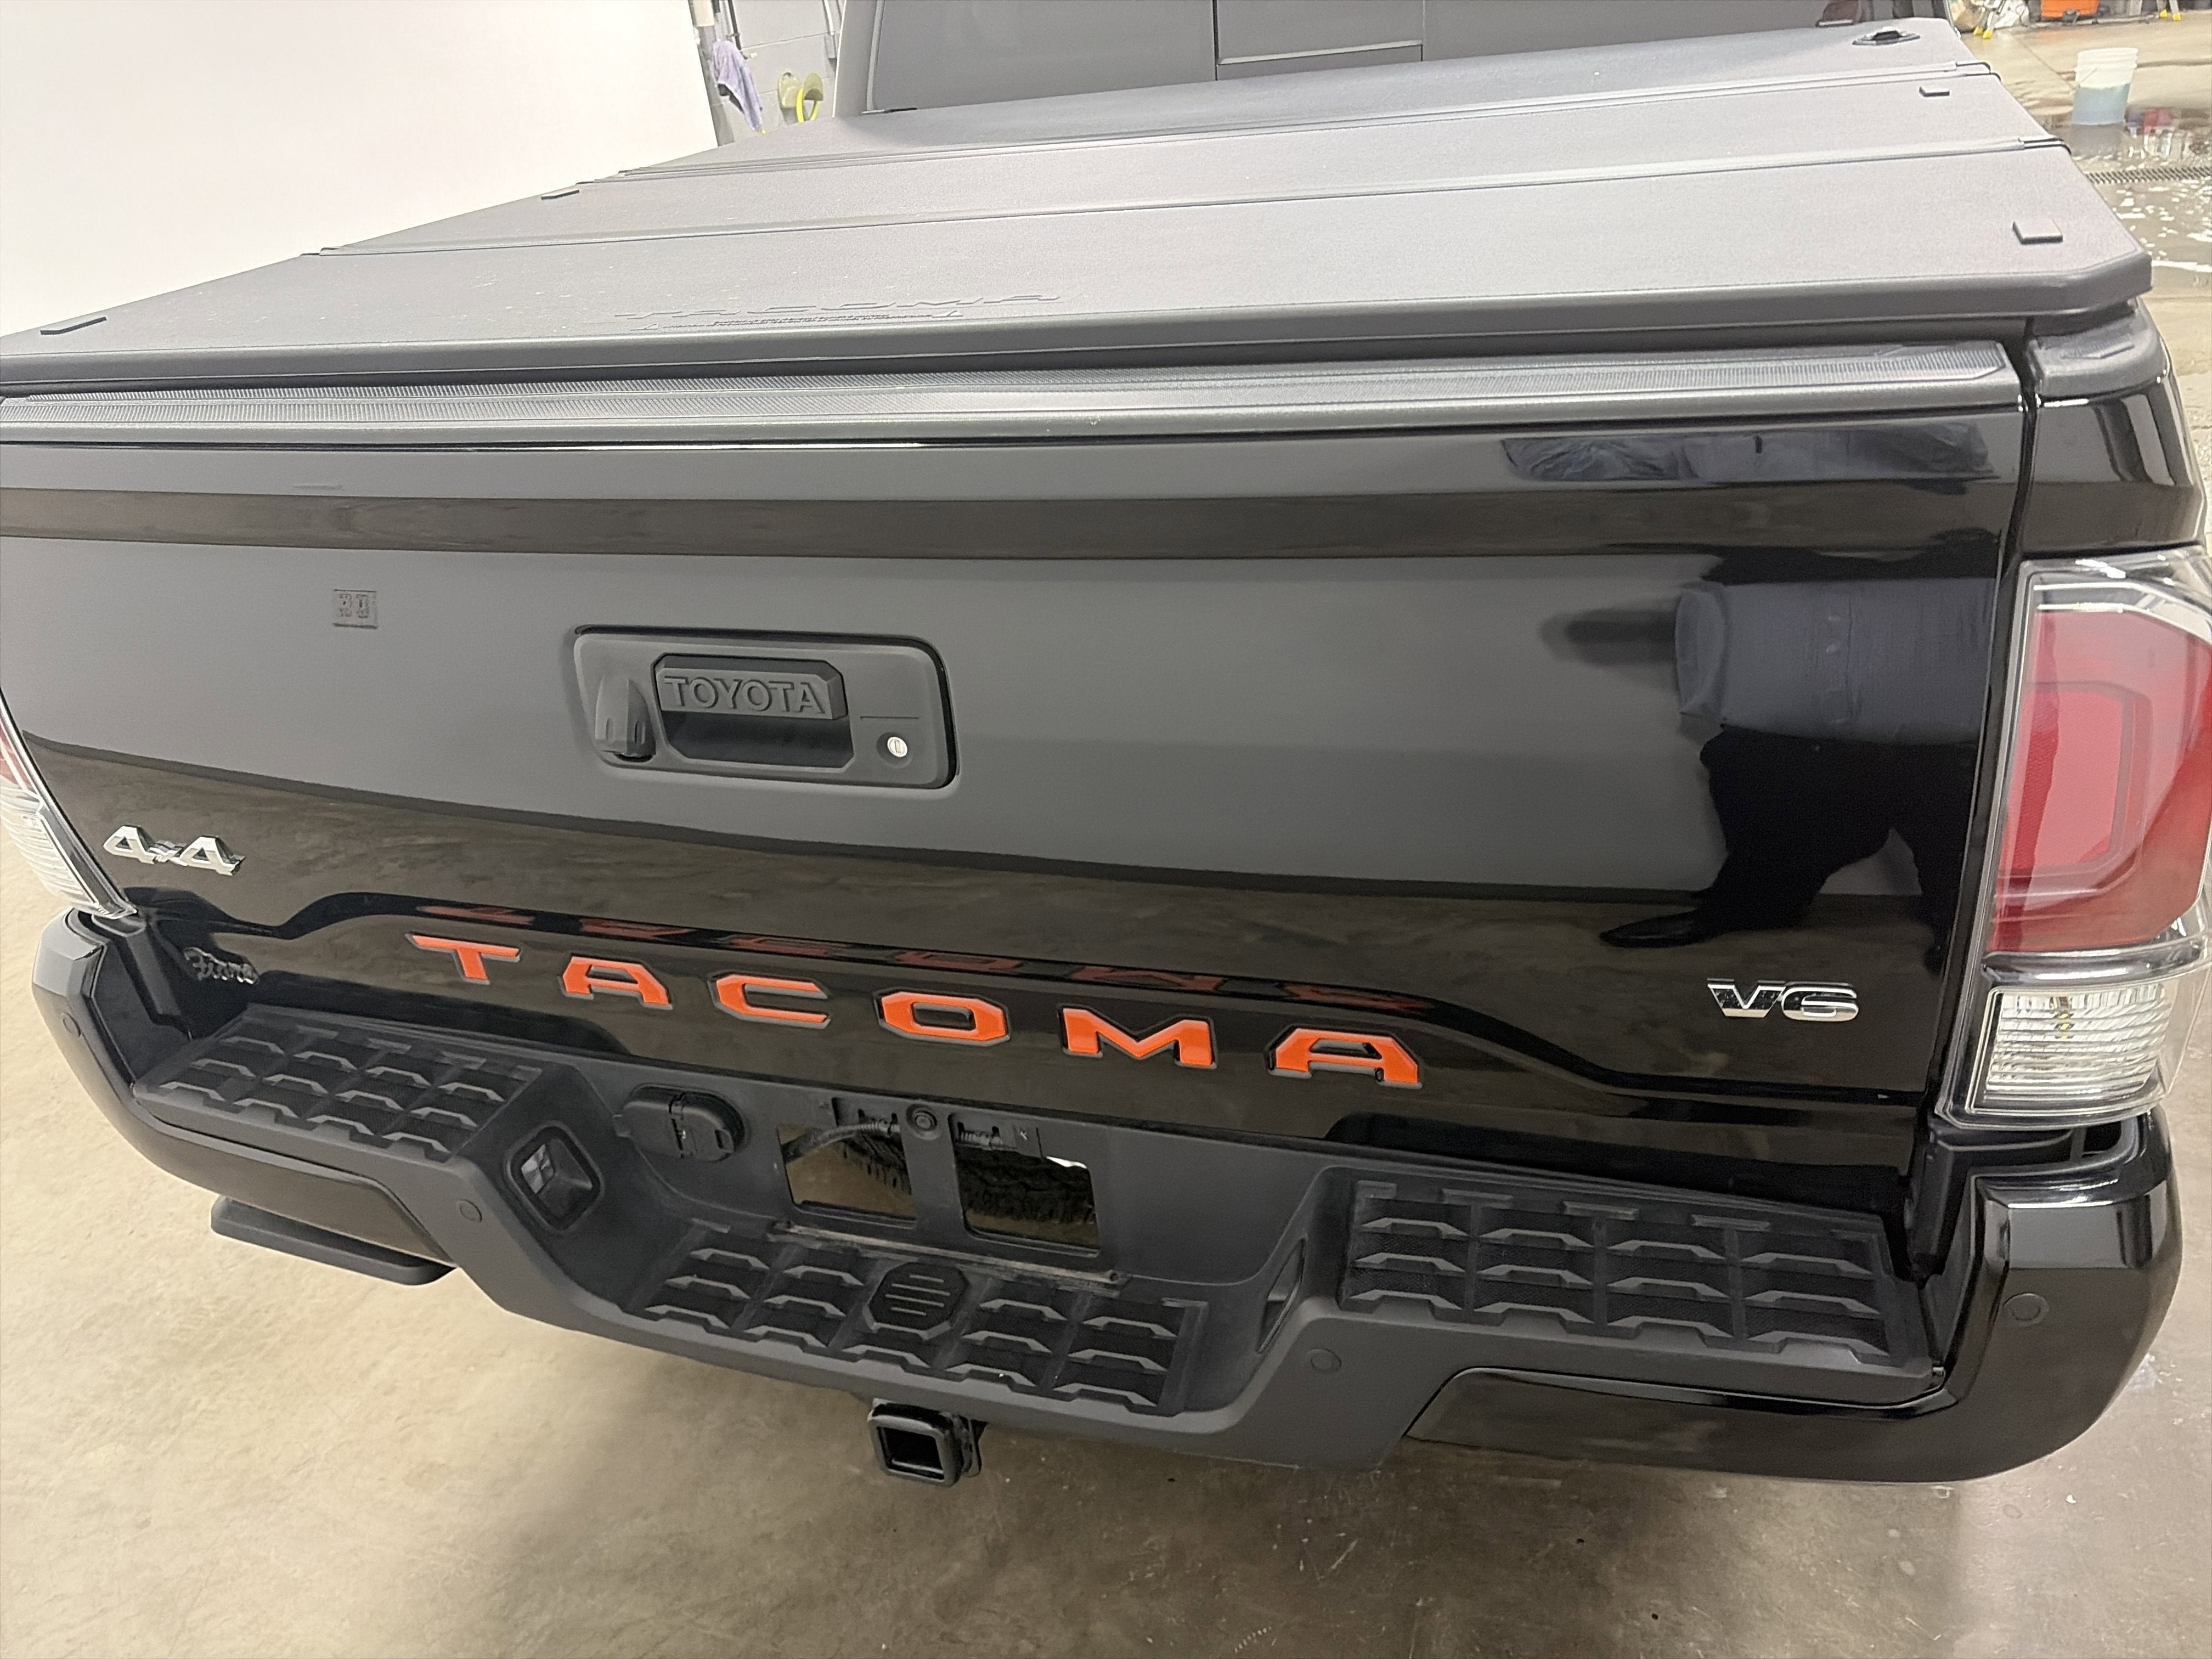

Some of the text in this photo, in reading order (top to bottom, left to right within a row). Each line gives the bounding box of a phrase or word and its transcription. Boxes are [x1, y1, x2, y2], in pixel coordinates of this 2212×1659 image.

[663, 675, 827, 715] TOYOTA
[406, 933, 1422, 1089] TACOMA
[1707, 978, 1859, 1022] V6
